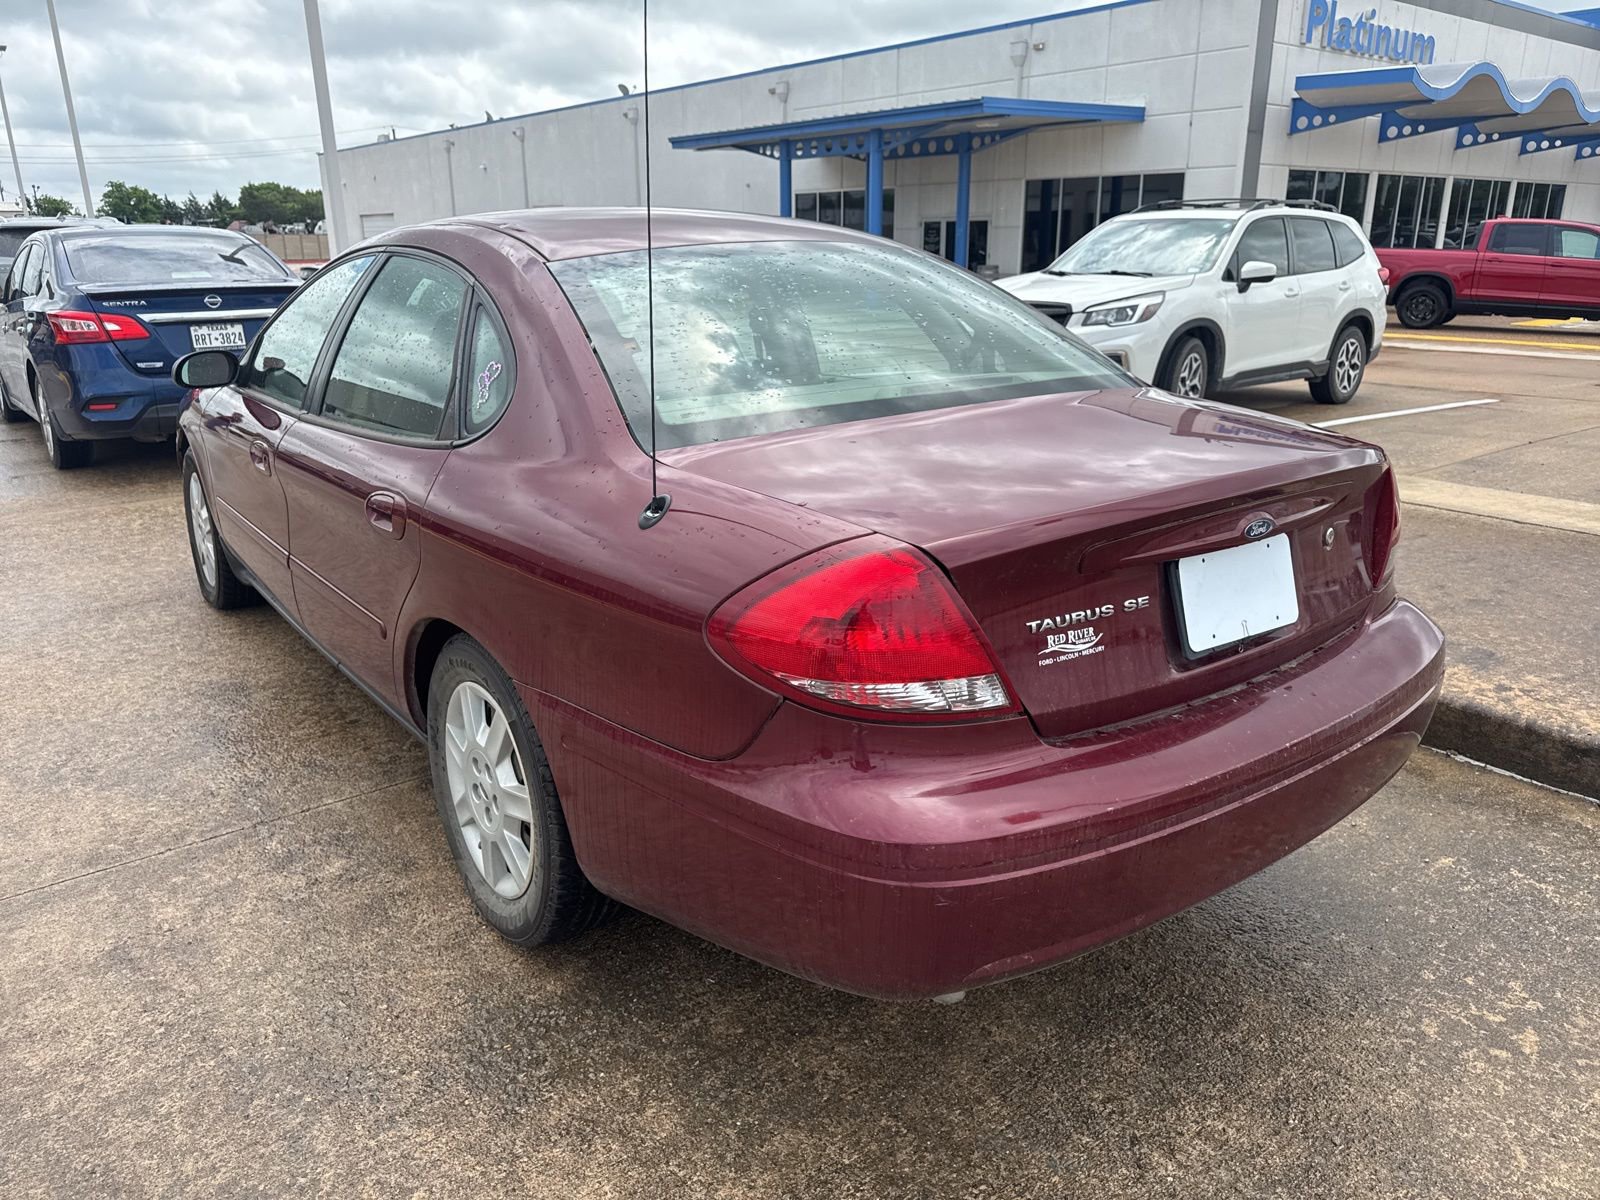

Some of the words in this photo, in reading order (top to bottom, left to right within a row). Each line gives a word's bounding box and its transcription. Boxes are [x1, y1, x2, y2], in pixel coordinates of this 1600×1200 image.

[1305, 0, 1436, 65] Platinum
[207, 323, 229, 331] TEXAS
[194, 333, 213, 346] RRT
[219, 331, 244, 345] 3824
[1250, 521, 1268, 536] Ford
[1026, 604, 1115, 634] TAURUS
[1123, 595, 1150, 612] SE
[1047, 633, 1067, 649] RED
[1067, 627, 1095, 644] RIVER
[1038, 658, 1054, 667] FORD
[1056, 651, 1079, 662] LINCOLN
[1082, 645, 1105, 656] MERCURY
